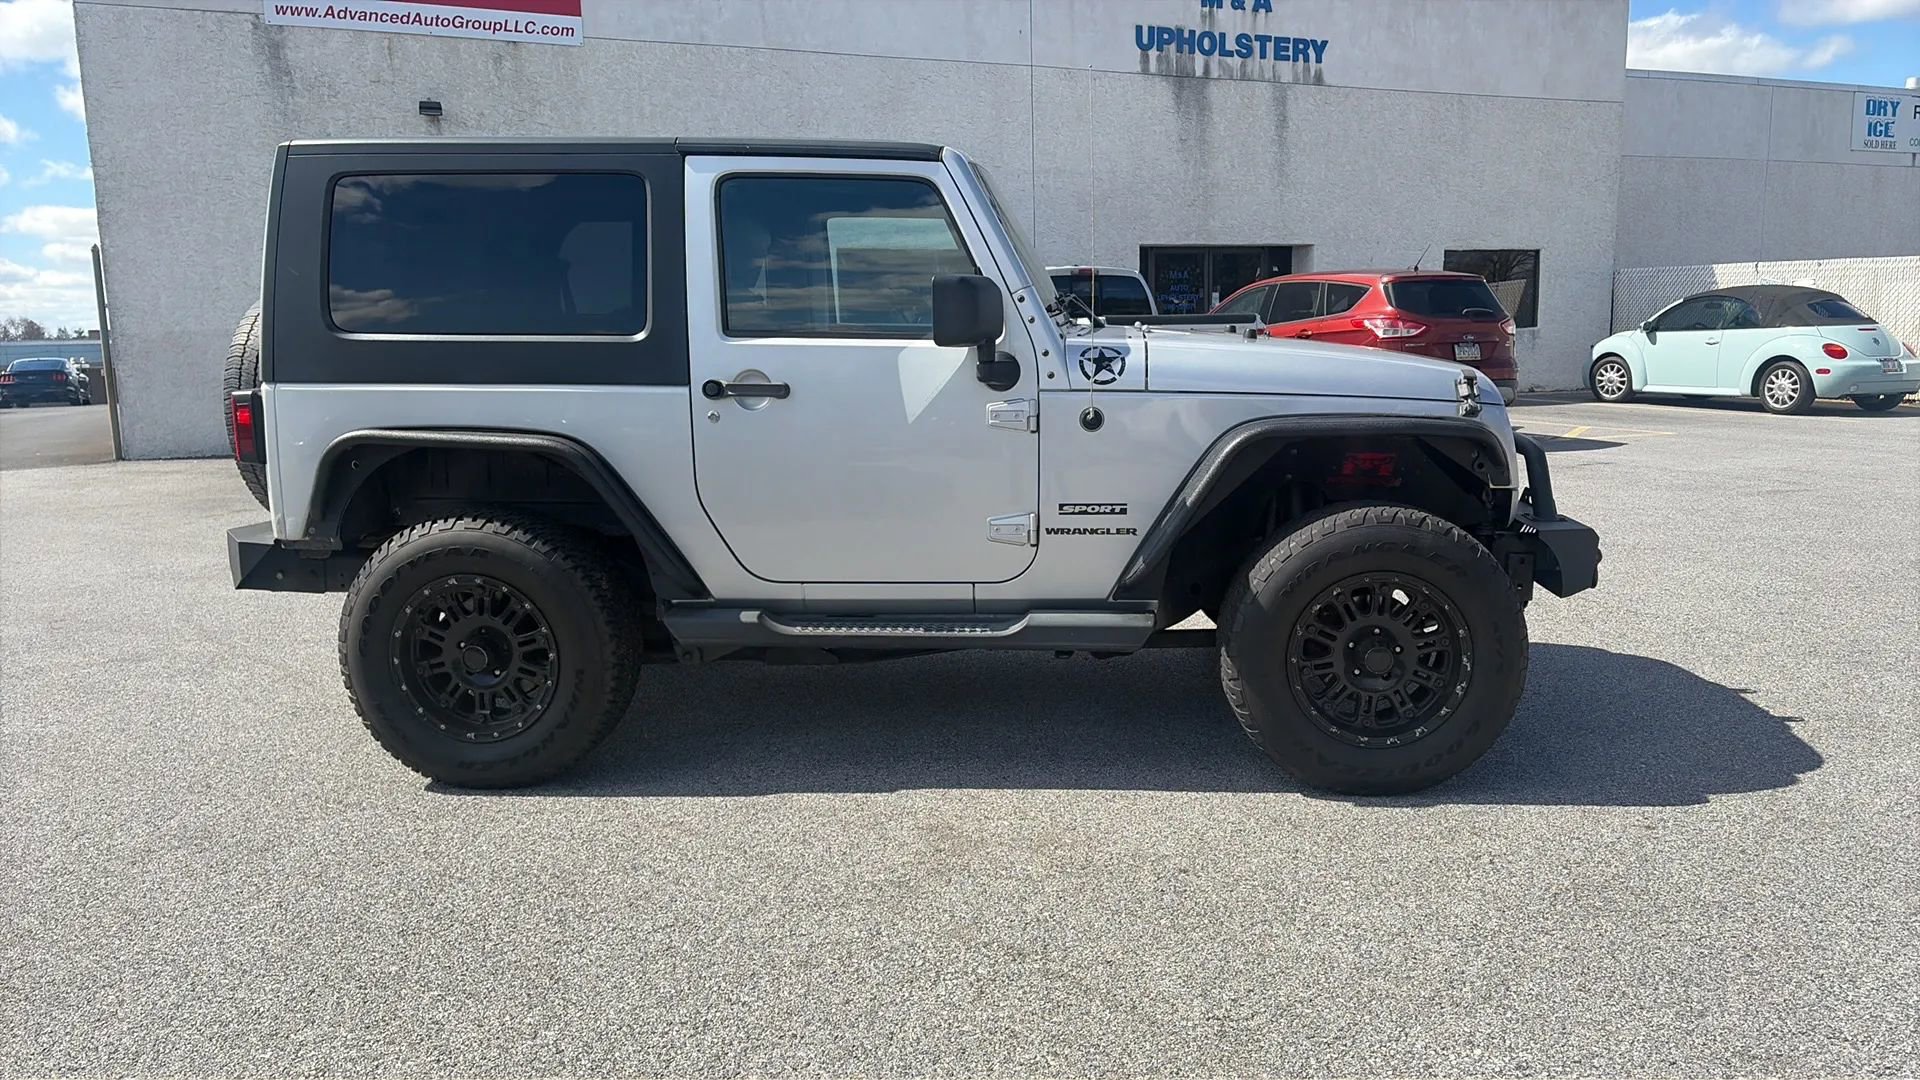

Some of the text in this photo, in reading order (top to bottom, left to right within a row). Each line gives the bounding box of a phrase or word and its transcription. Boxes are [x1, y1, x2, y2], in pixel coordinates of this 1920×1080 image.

[274, 4, 576, 38] www.AdvancedAutoGroupLLC.com
[1135, 25, 1329, 64] UPHOLSTERY
[1865, 97, 1901, 117] DRY
[1867, 119, 1896, 138] ICE
[1864, 139, 1897, 150] SOLD HERE
[1059, 504, 1127, 514] SPORT
[1045, 527, 1138, 537] WRANGLER
